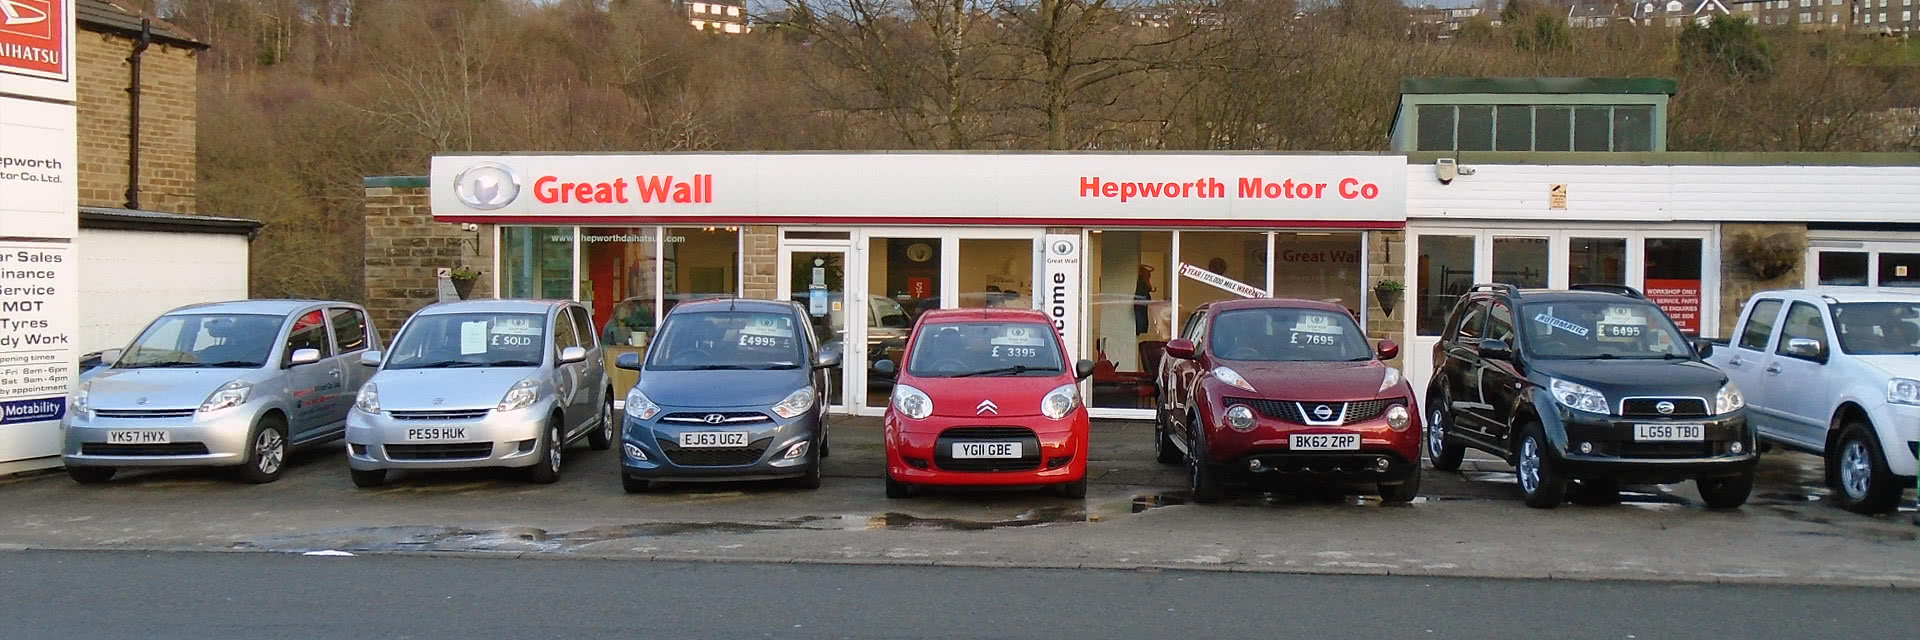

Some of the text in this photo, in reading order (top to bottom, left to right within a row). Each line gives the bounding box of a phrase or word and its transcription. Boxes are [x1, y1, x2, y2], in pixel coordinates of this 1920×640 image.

[20, 172, 39, 181] Co.
[41, 174, 62, 183] Ltd.
[534, 174, 712, 204] Great Wall
[1080, 176, 1379, 202] Hepworth Motor Co
[17, 251, 63, 263] Sales
[1283, 249, 1361, 264] Great Wal
[1, 268, 55, 279] inance
[1180, 263, 1189, 275] 6
[1188, 268, 1202, 278] YEAR
[1223, 280, 1237, 290] MILE
[0, 285, 55, 295] ervice
[3, 301, 44, 312] MOT
[1053, 272, 1065, 337] come
[0, 319, 48, 332] Tyres
[1540, 315, 1586, 335] AUTOMATIC
[1612, 326, 1640, 336] 6495
[24, 333, 69, 345] Work
[491, 335, 531, 346] £ SOLD
[1290, 332, 1334, 345] £ 7695
[991, 346, 1036, 357] £ 3395
[12, 385, 67, 394] appointment
[6, 401, 60, 417] Motability
[110, 431, 165, 441] YK57 HVX
[409, 428, 465, 440] PE59 HUK
[1641, 426, 1672, 438] LG58
[685, 434, 743, 445] EJ63 UGZ
[1296, 436, 1355, 447] BK62 ZRP
[963, 444, 1012, 456] YG11 GBE
